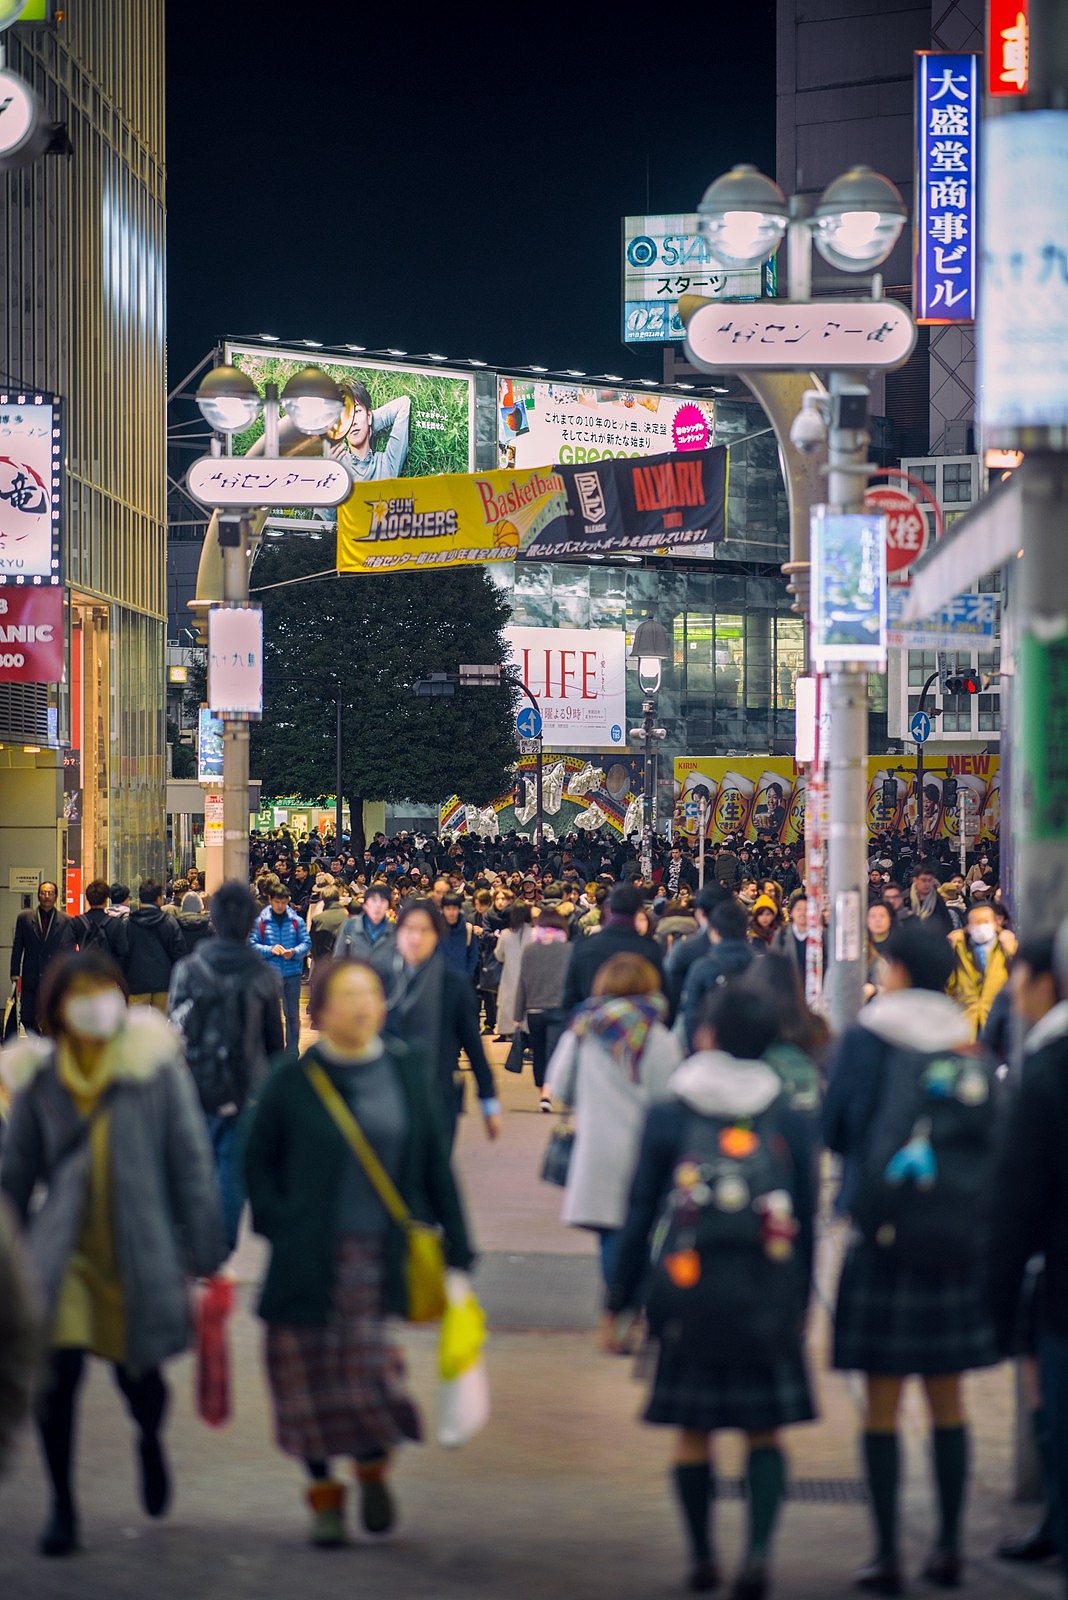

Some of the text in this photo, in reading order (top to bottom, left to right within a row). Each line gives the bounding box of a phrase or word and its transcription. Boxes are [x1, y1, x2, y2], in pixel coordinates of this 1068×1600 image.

[928, 68, 969, 309] 大盛堂商事ビル
[656, 276, 728, 294] スターツ
[627, 307, 667, 331] OZ
[632, 460, 706, 512] ALVARK
[388, 498, 414, 514] SUN
[475, 472, 563, 525] Basketball
[353, 501, 459, 542] ROCKERS
[521, 648, 598, 700] LIFE
[677, 762, 698, 770] KIRIN
[947, 755, 991, 775] NEW
[257, 810, 272, 821] JR
